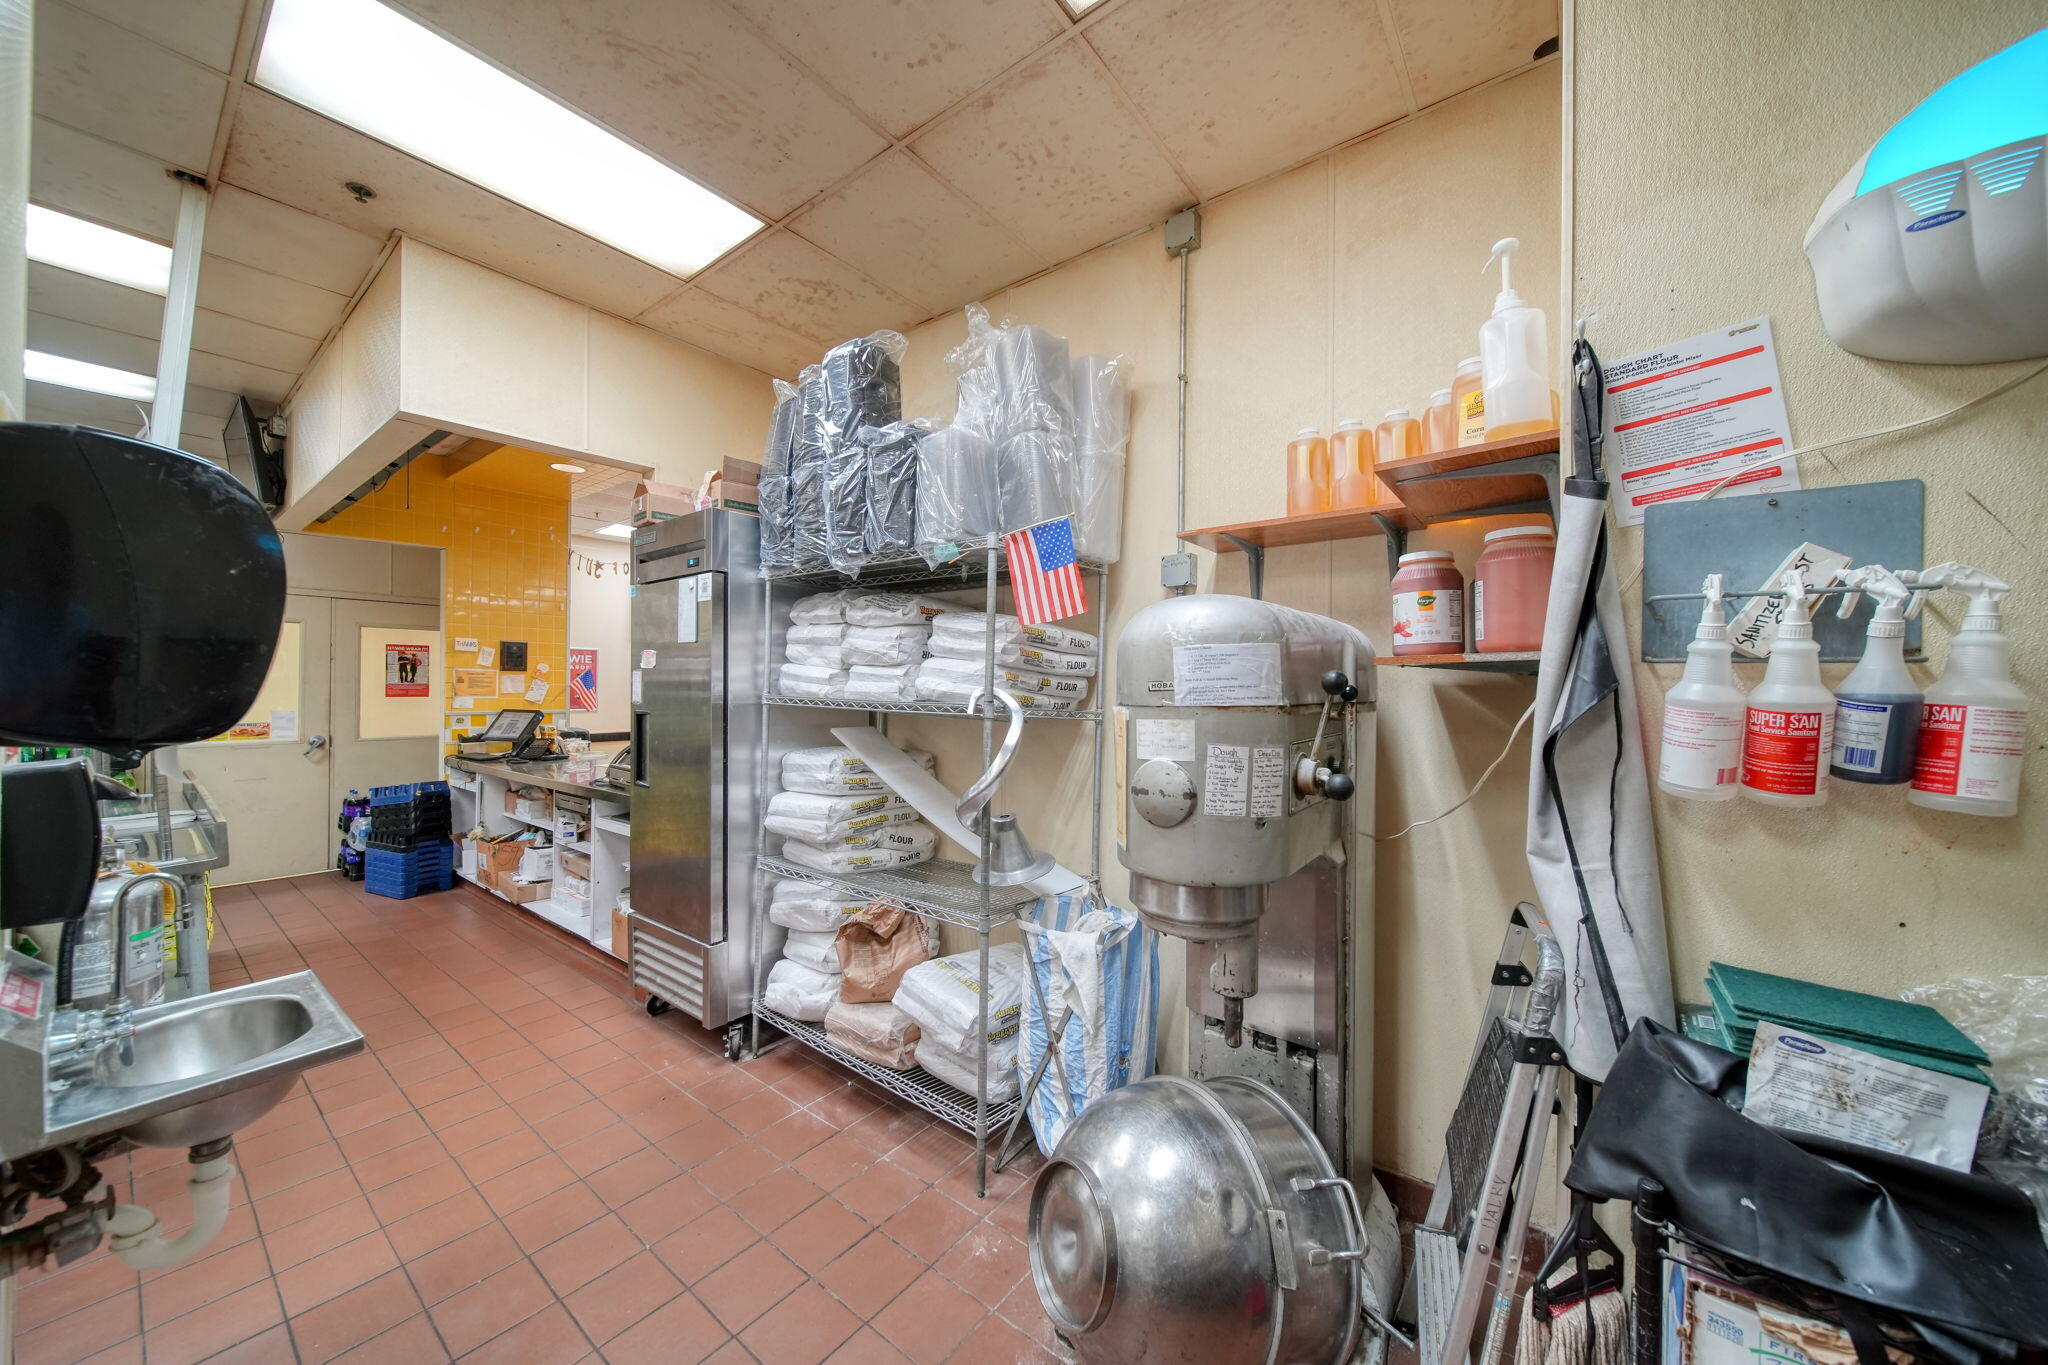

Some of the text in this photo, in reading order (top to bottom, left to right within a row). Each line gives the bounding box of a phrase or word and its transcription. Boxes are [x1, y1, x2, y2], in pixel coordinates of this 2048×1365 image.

[1603, 353, 1664, 375] DOUGH CHART
[1604, 354, 1679, 380] STANDARD FLOUR
[1605, 376, 1625, 385] Hobart
[1466, 426, 1484, 435] Corn
[570, 655, 592, 664] WIE
[1066, 661, 1087, 670] FLOUR
[1056, 682, 1078, 692] FLOUR
[1052, 702, 1071, 710] FLOUR
[1931, 706, 1963, 722] SAN
[1750, 710, 1819, 729] SUPER SAN
[1929, 720, 1961, 730] Sanitizer
[1760, 725, 1785, 735] Service
[1787, 728, 1818, 736] Sanitizer
[1211, 746, 1239, 758] Dough
[894, 813, 912, 821] FLOU
[889, 834, 914, 845] FLOUR
[1769, 1340, 1817, 1365] FIRS
